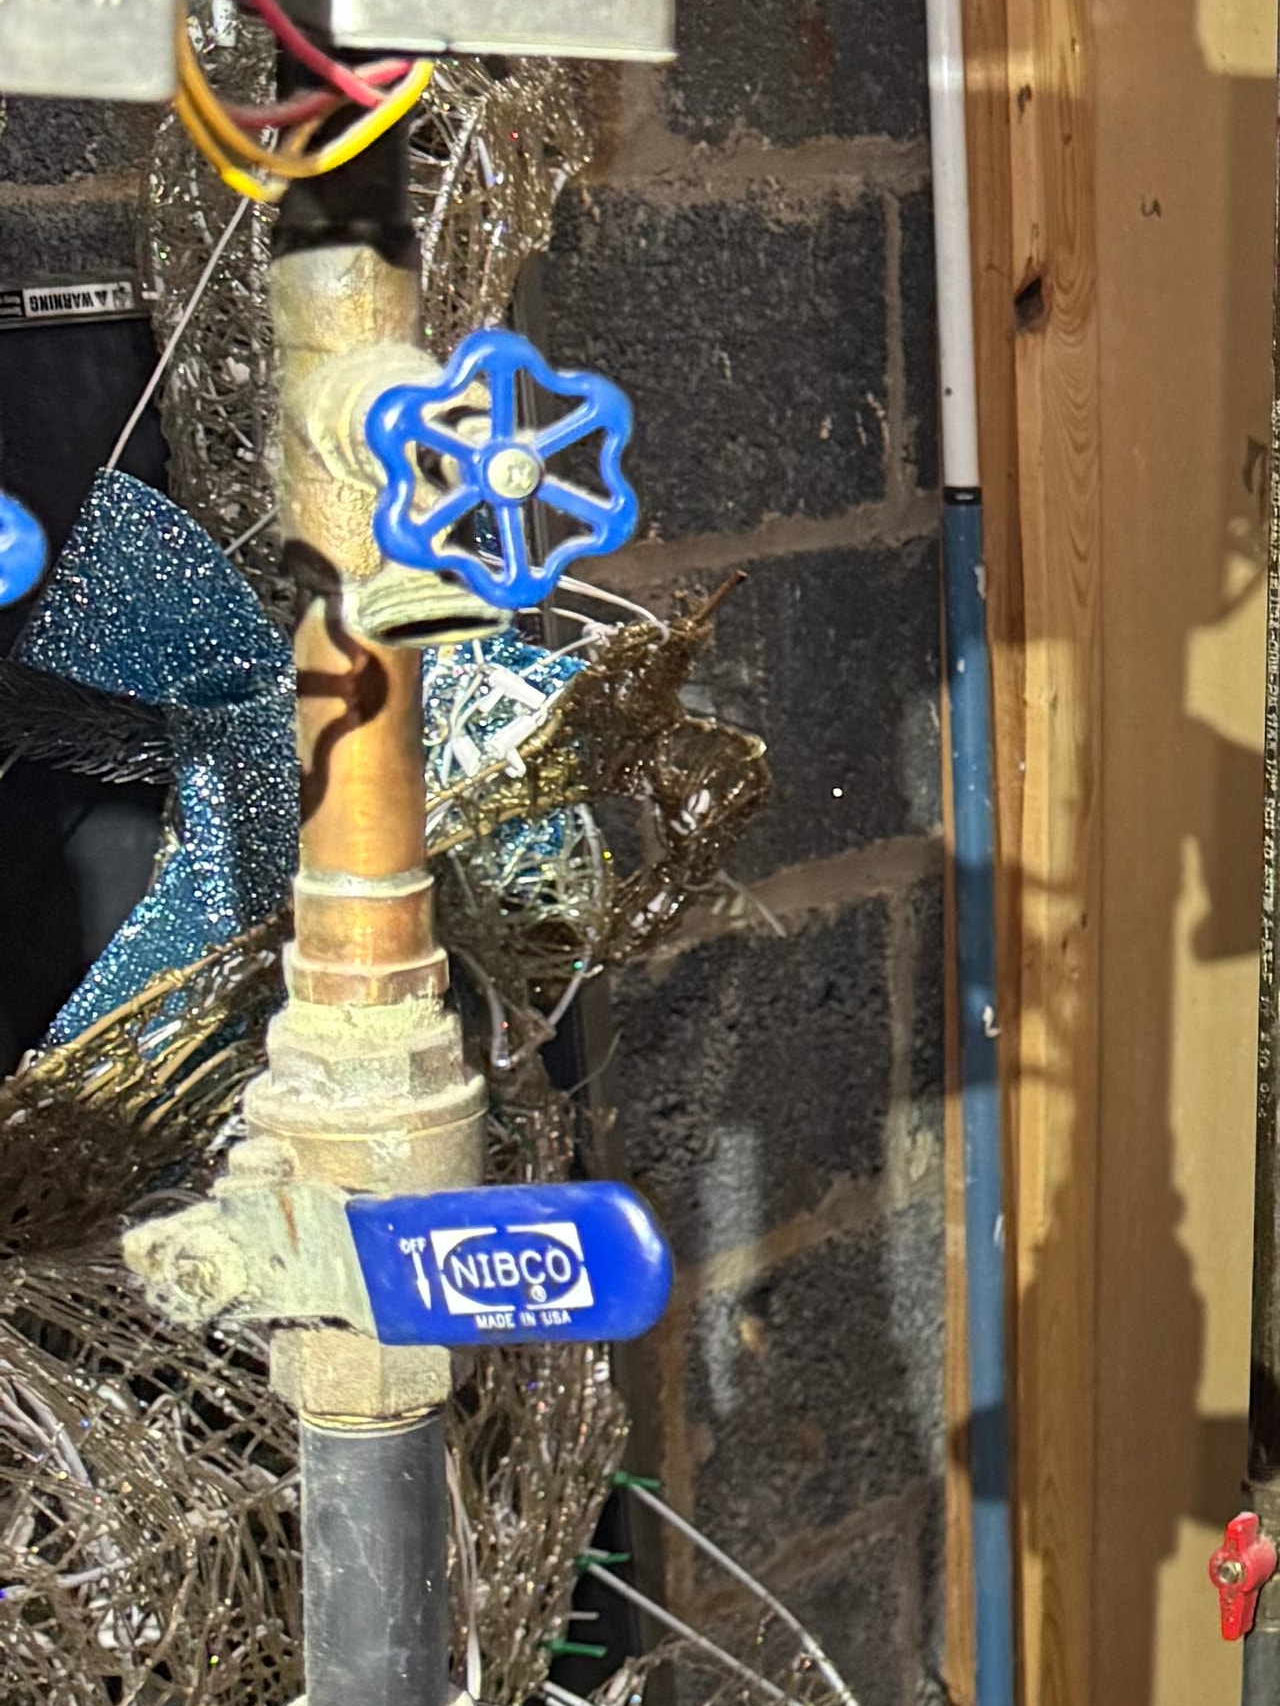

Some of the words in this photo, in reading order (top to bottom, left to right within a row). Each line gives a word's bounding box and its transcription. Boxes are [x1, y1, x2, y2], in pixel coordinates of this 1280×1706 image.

[30, 291, 94, 313] WARNING
[400, 1237, 426, 1255] OFF
[451, 1248, 571, 1289] NIBCO
[475, 1313, 515, 1329] MADE
[521, 1312, 536, 1326] IN
[542, 1310, 571, 1325] USA
